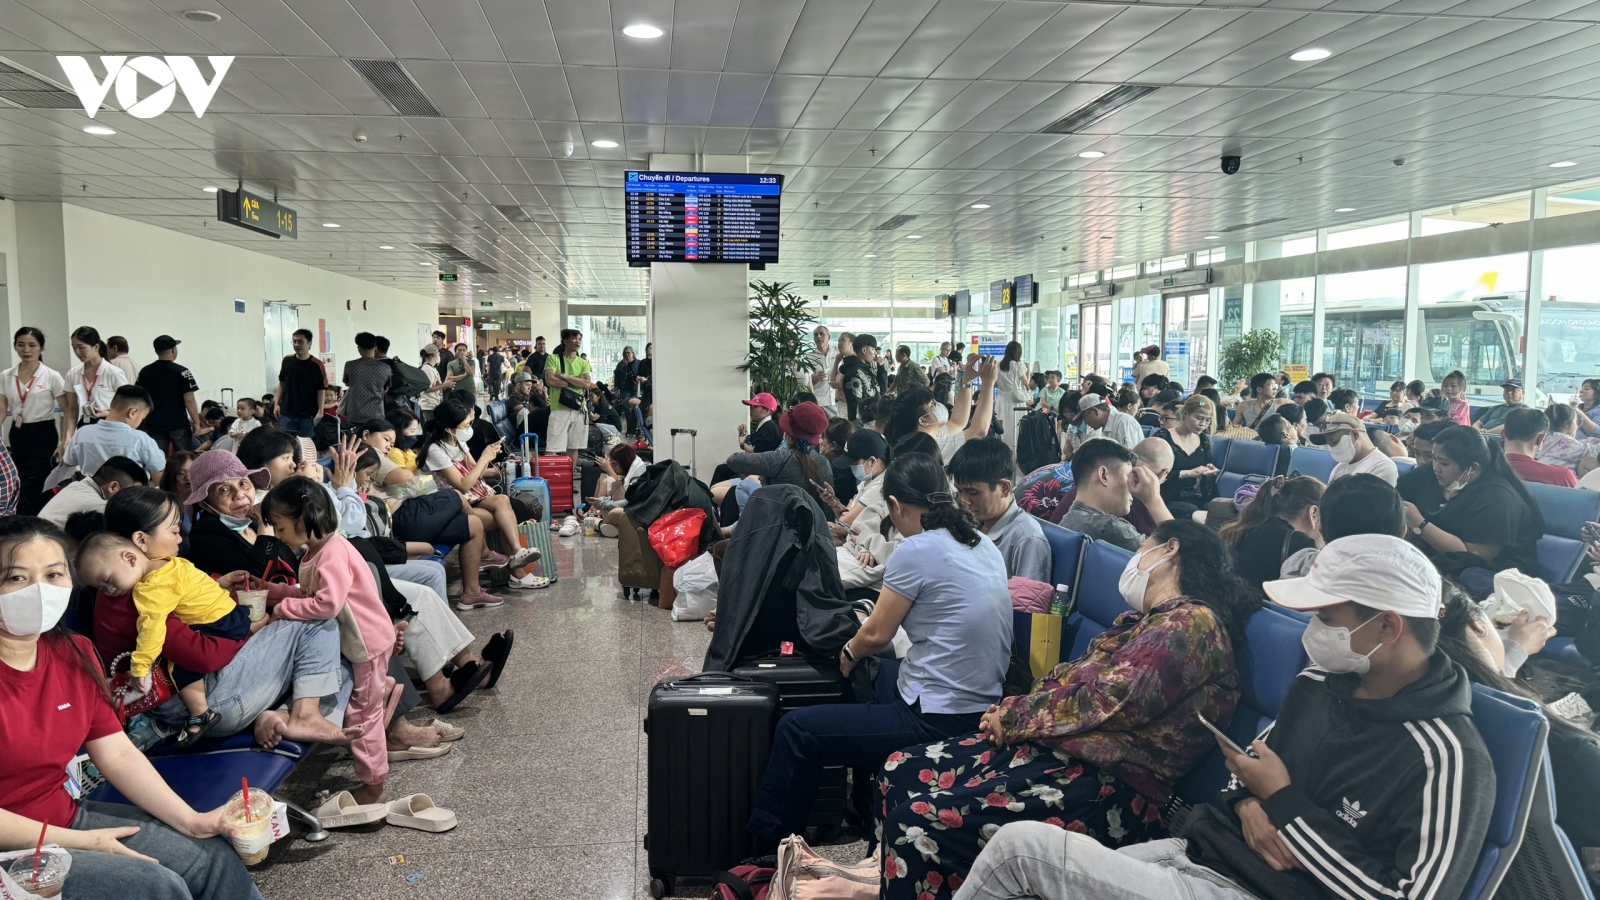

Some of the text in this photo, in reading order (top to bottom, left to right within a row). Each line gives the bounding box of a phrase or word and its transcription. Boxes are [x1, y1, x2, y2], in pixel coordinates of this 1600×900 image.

[676, 175, 710, 184] Departures
[277, 210, 292, 232] 1-15
[1002, 288, 1010, 304] 23
[942, 300, 948, 313] 22
[1336, 810, 1358, 828] adidas
